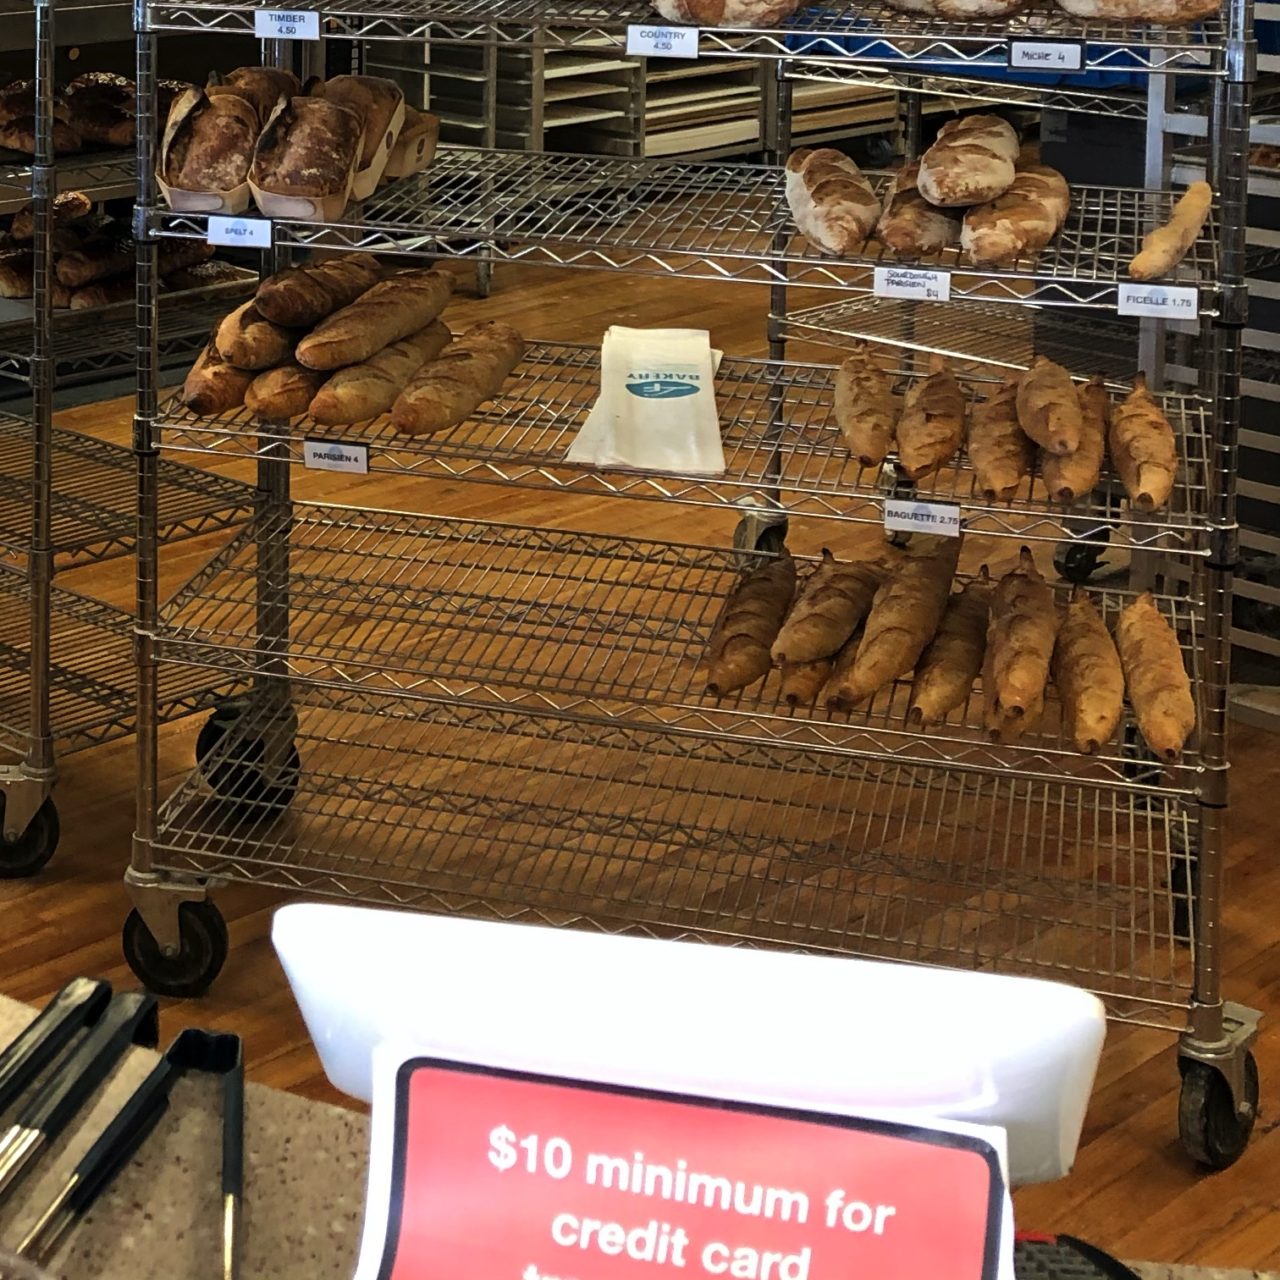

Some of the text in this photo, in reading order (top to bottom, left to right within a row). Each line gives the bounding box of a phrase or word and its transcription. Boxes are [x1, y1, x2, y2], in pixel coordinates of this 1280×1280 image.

[269, 14, 306, 23] TIMBER
[277, 26, 296, 34] 4.50
[640, 30, 686, 39] COUNTRY
[653, 42, 672, 50] 4.50
[1057, 52, 1065, 62] 4
[225, 227, 247, 235] SPELT
[1126, 295, 1192, 308] FICELLE 1.75
[312, 451, 352, 463] PARISIEN
[887, 510, 959, 525] BAGUETTE 2.75
[488, 1124, 897, 1236] $10 minimum for
[551, 1213, 812, 1280] credit card
